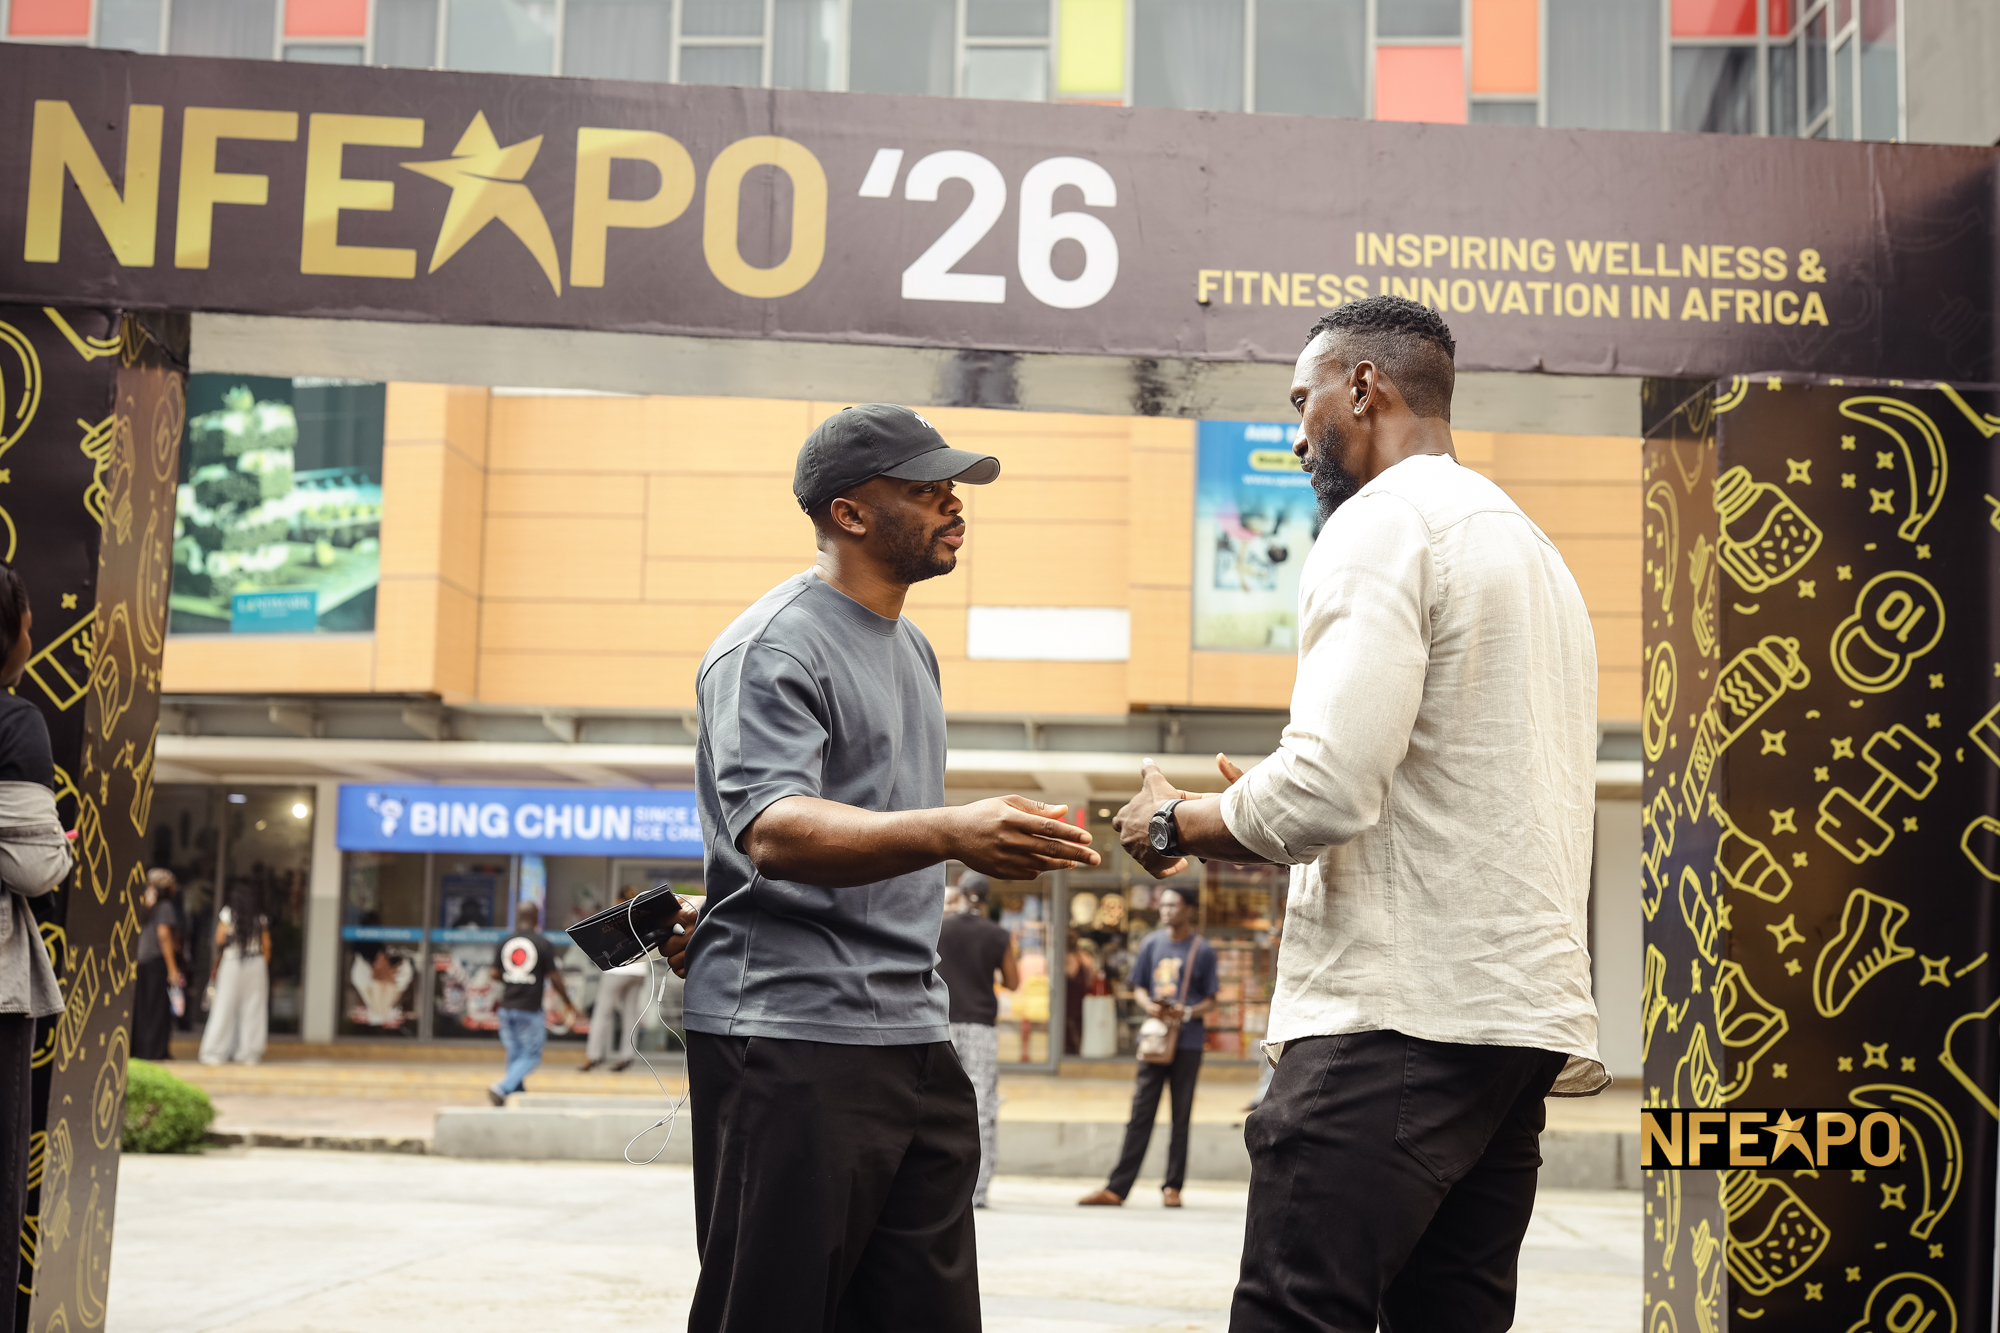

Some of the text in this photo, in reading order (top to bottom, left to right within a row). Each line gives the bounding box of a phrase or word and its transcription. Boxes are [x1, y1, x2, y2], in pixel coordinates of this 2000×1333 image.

[1355, 231, 1828, 283] INSPIRING WELLNESS &
[1198, 269, 1829, 326] FITNESS INNOVATION IN AFRICA
[409, 801, 632, 842] BING CHUN
[632, 823, 664, 842] ICE
[633, 805, 689, 824] SINCE
